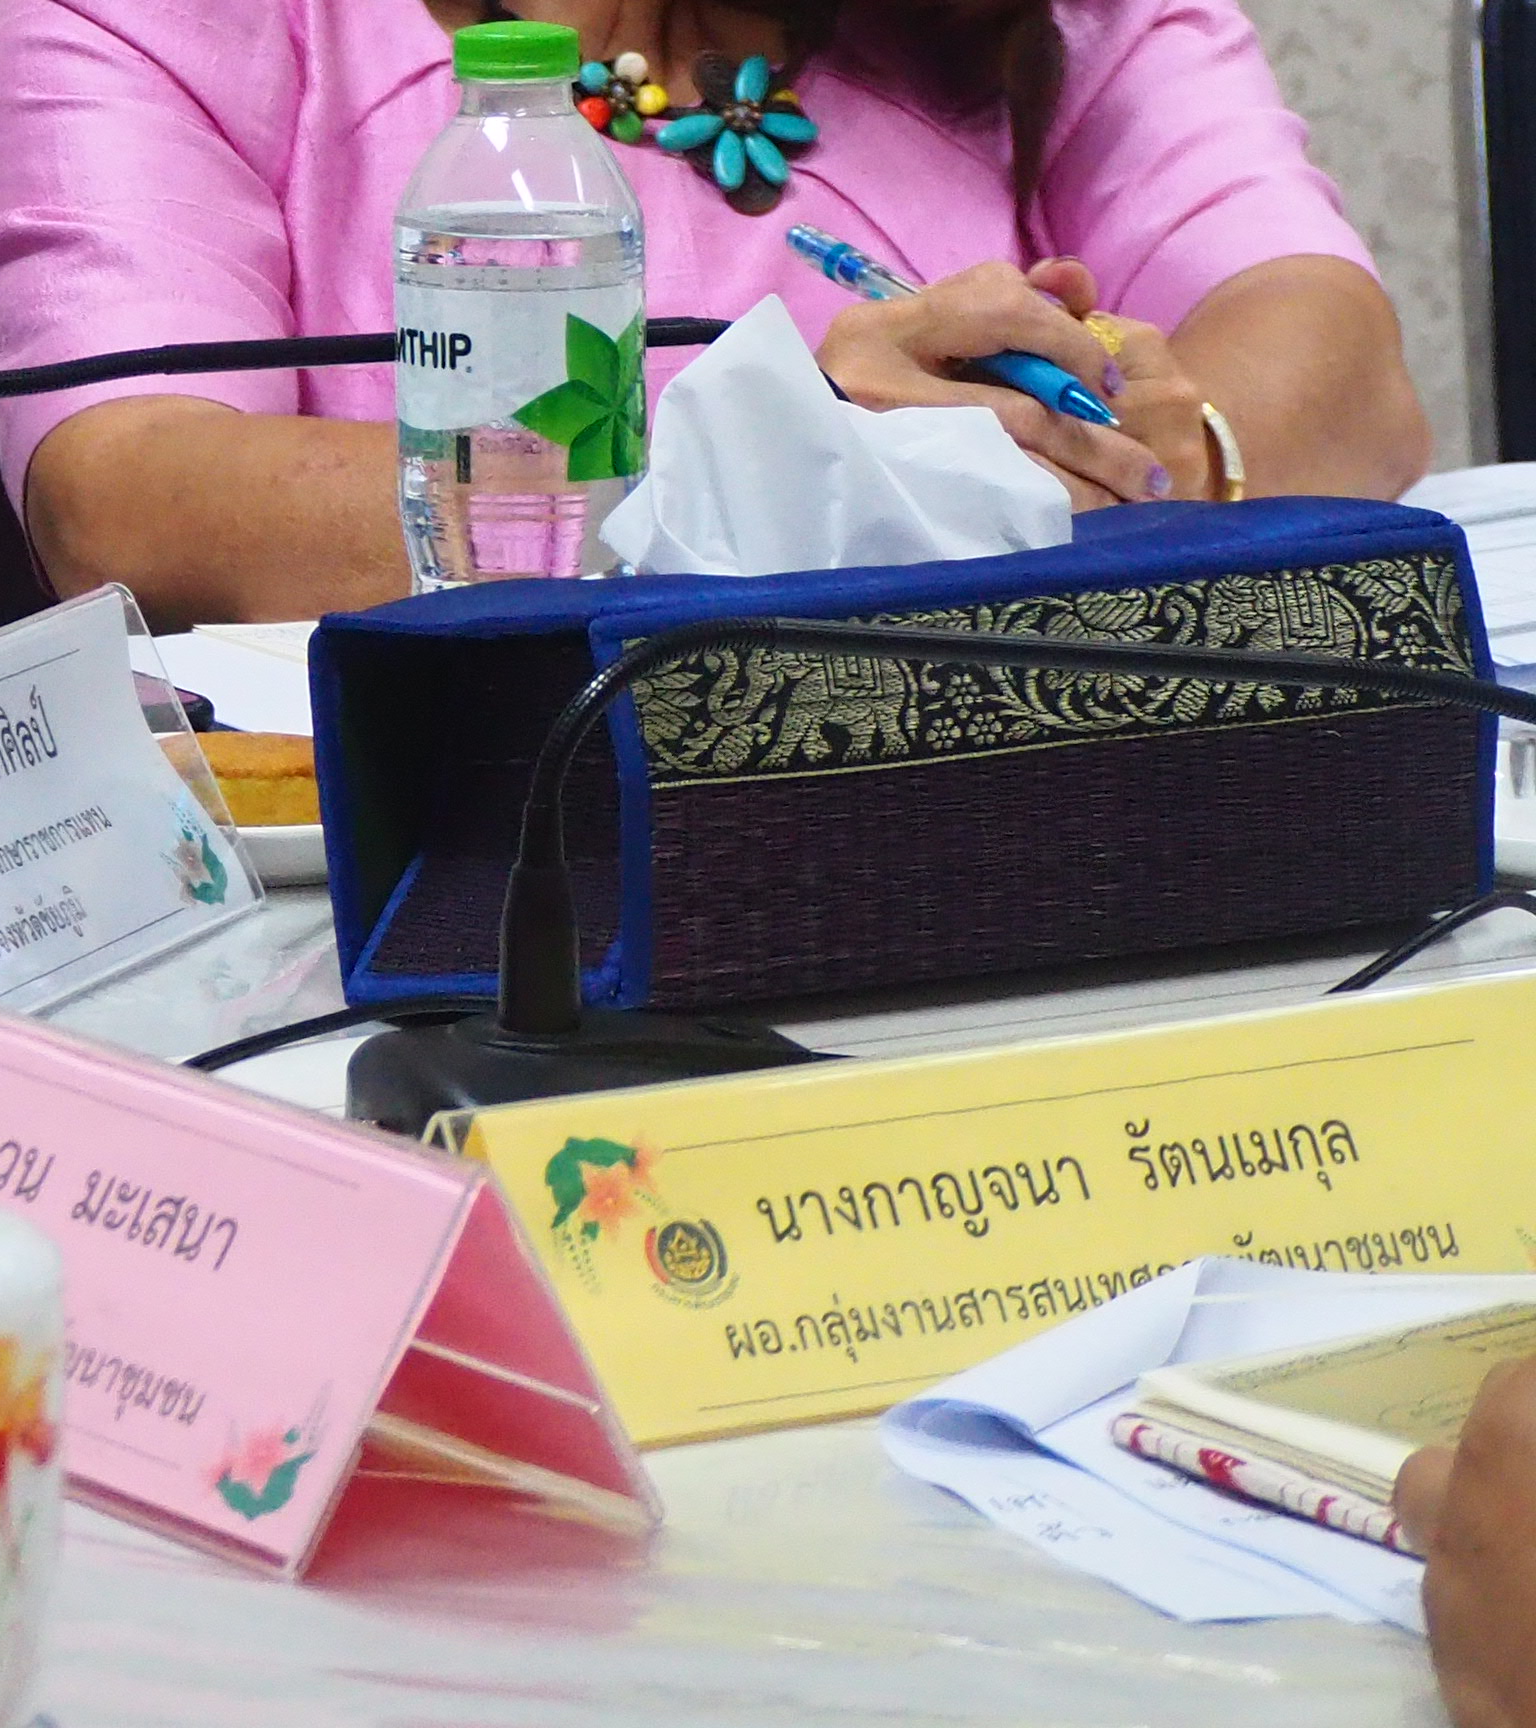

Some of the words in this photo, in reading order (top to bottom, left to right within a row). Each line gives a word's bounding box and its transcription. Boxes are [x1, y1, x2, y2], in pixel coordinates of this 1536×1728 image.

[70, 1169, 240, 1272] มะเสนา
[755, 1154, 1092, 1243] นางกาญจนา
[1124, 1118, 1361, 1192] รัตนเมกุล
